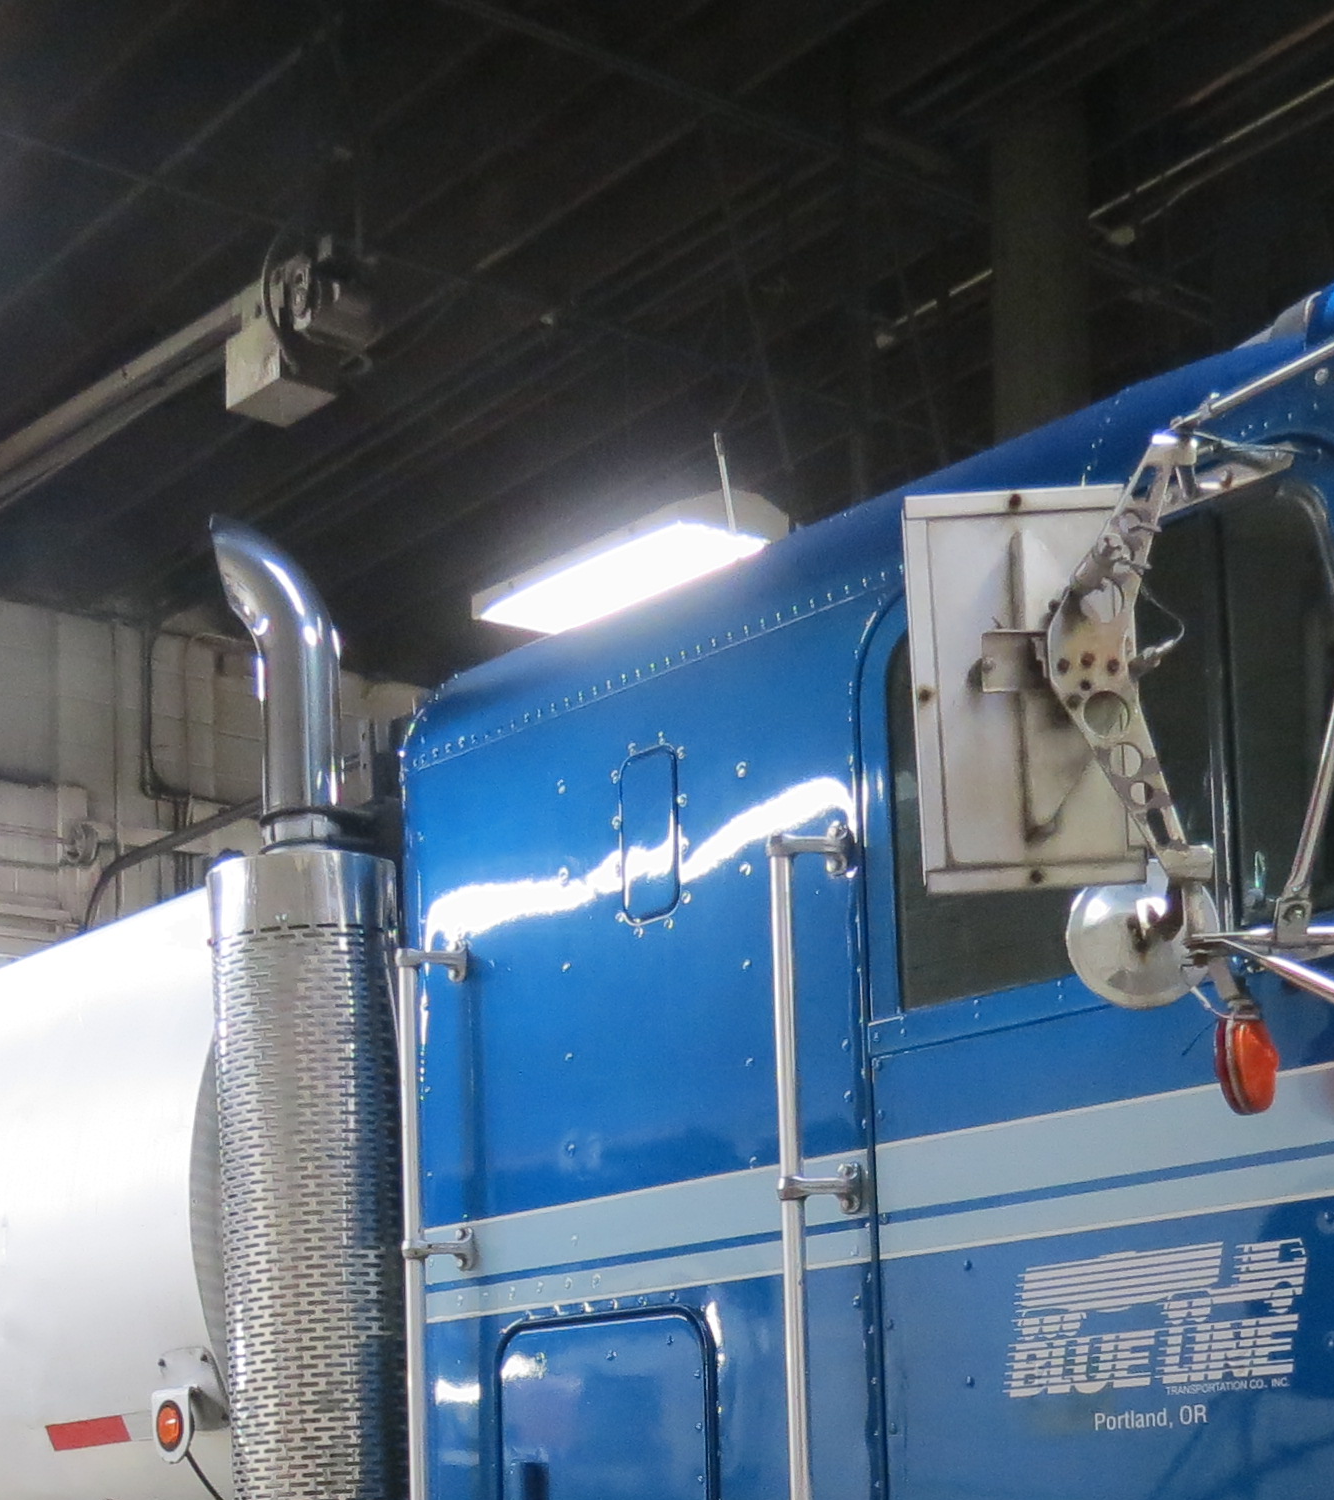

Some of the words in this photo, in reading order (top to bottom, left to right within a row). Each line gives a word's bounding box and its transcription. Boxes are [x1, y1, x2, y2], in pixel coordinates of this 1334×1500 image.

[1003, 1329, 1156, 1398] BLUE
[1154, 1313, 1299, 1384] LINE
[1166, 1380, 1247, 1396] TRANSPORTATION
[1271, 1377, 1290, 1388] INC.
[1094, 1409, 1173, 1431] Portland,
[1179, 1404, 1208, 1425] OR
